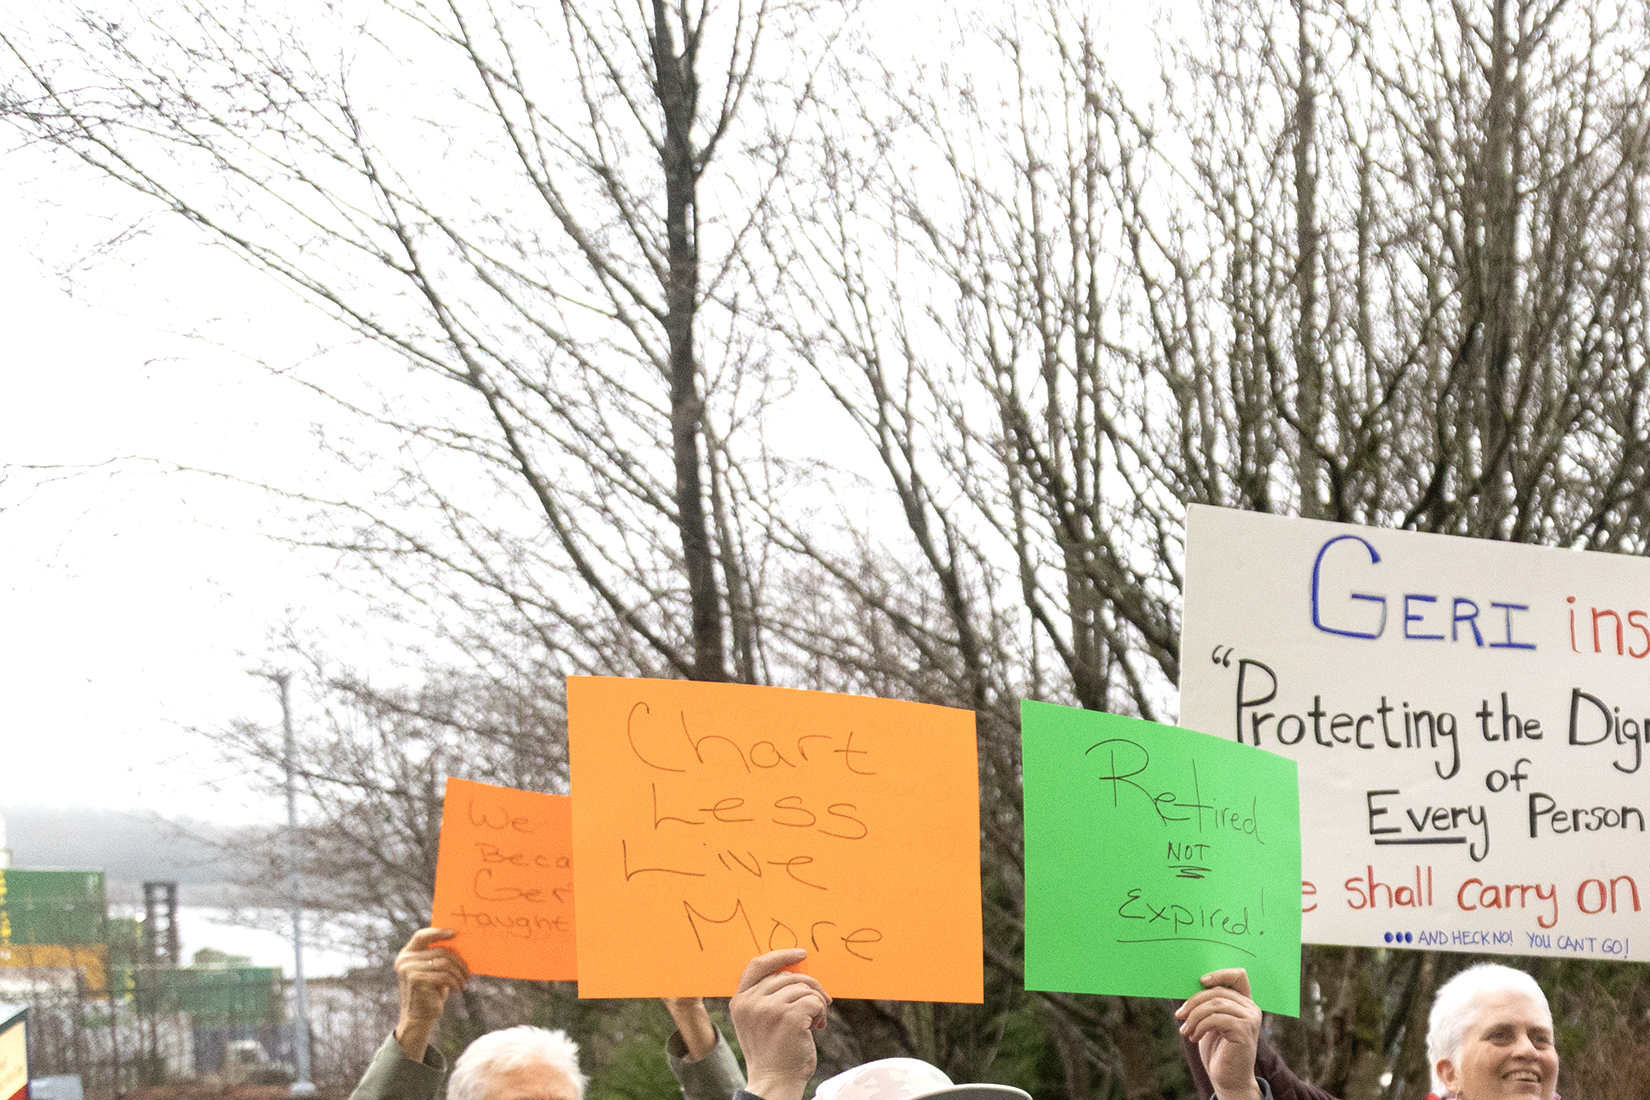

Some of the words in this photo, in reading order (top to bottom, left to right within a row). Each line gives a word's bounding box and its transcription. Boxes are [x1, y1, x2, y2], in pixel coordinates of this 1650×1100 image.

[1312, 535, 1537, 651] GERI
[628, 702, 876, 776] Chart
[1476, 692, 1544, 744] the
[1085, 738, 1265, 845] Retired
[1485, 758, 1528, 794] of
[468, 799, 534, 833] We
[652, 783, 868, 839] Less
[1366, 789, 1489, 862] Every
[475, 842, 571, 869] Beca
[622, 839, 828, 891] Live
[1167, 841, 1211, 861] NOT
[473, 867, 573, 903] Ger
[1301, 880, 1317, 913] e
[1345, 865, 1433, 912] shall
[1457, 875, 1559, 928] carry
[450, 904, 569, 938] taught
[683, 898, 883, 961] More
[1118, 887, 1264, 936] Expired!
[1418, 931, 1448, 945] AND
[1452, 931, 1490, 945] HECK
[1493, 930, 1513, 944] NO!
[1527, 932, 1552, 949] YOU
[1557, 936, 1597, 953] CAN'T
[1602, 938, 1630, 959] GO!
